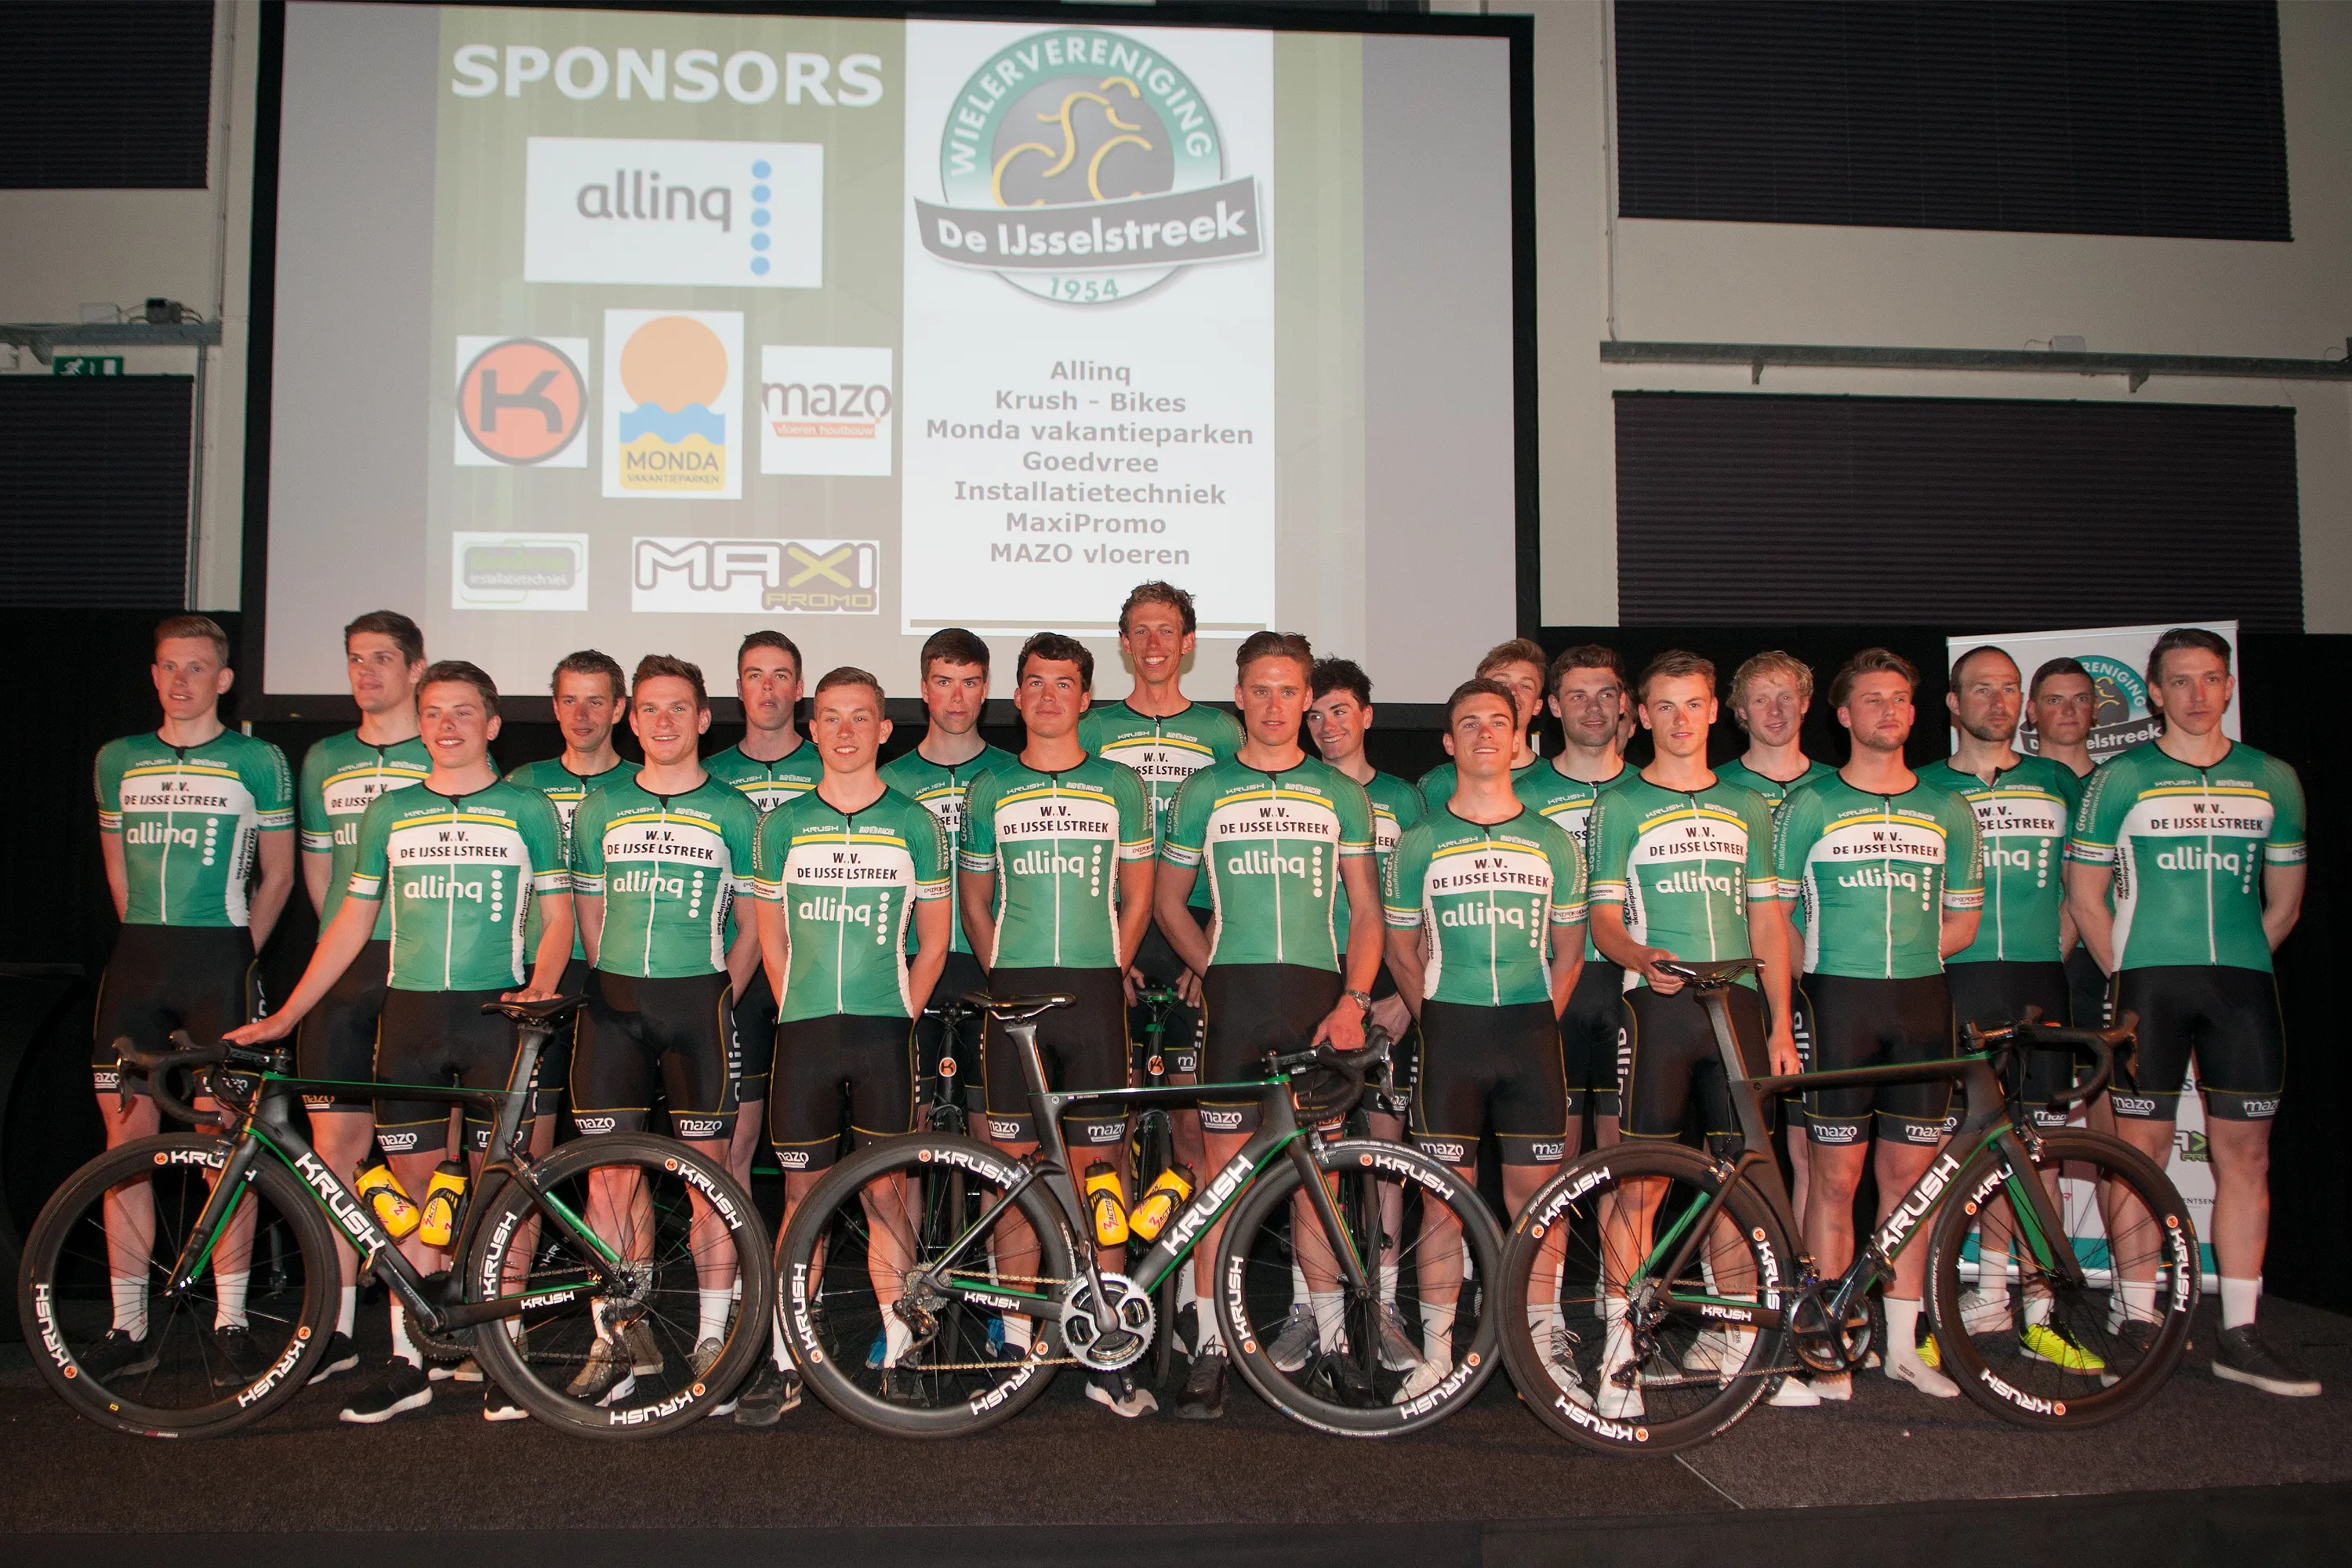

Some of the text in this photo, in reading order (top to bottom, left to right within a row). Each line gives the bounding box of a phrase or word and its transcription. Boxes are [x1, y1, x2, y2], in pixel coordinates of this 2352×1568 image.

[451, 43, 884, 107] SPONSORS
[949, 35, 1214, 177] WIELERVERENIGING
[575, 169, 732, 234] allinq
[938, 200, 1249, 256] De IJsselstreek
[1049, 276, 1120, 301] 1954
[1050, 360, 1131, 387] Allinq
[479, 368, 564, 434] K
[762, 383, 892, 418] mazo
[996, 389, 1079, 411] Krush
[1110, 392, 1186, 412] Bikes
[926, 419, 1253, 447] Monda vakantieparken
[626, 450, 719, 471] MONDA
[1022, 451, 1159, 473] Goedvree
[626, 474, 720, 485] VAKANTIEPARKEN
[954, 481, 1226, 504] Installatietechniek
[1006, 512, 1167, 534] MaxiPromo
[634, 539, 877, 591] MAXI
[990, 543, 1190, 565] MAZO vloeren
[764, 591, 873, 609] PROMO
[124, 794, 228, 808] DE IJSSELSTREEK
[331, 798, 343, 808] DE
[126, 822, 198, 848] allinq
[1004, 822, 1109, 835] DE IJSSELSTREEK
[1220, 822, 1329, 834] DE IJSSELSTREEK
[2151, 817, 2263, 831] DE IJSSELSTREEK
[401, 846, 508, 858] DE IJSSELSTREEK
[607, 844, 713, 860] DE IJSSELSTREEK
[1650, 841, 1744, 857] DE IJSSELSTREEK
[1833, 844, 1940, 858] DE IJSSELSTREEK
[2157, 846, 2240, 876] allinq
[797, 866, 897, 880] DE IJSSELSTREEK
[1013, 851, 1084, 878] allinq
[1228, 851, 1305, 878] allinq
[404, 875, 483, 903] allinq
[612, 871, 684, 898] allinq
[1432, 873, 1549, 889] DE IJSSELSTREEK
[1655, 870, 1732, 896] allinq
[799, 896, 872, 926] allinq
[1441, 902, 1524, 929] allinq
[934, 1149, 1014, 1190] KRUSH
[1374, 1154, 1456, 1200] KRUSH
[294, 1152, 387, 1255] KRUSH
[677, 1163, 743, 1229] KRUSH
[1161, 1154, 1254, 1256] KRUSH
[1539, 1166, 1611, 1227] KRUSH
[1880, 1153, 1960, 1257] KRUSH
[481, 1211, 518, 1295] KRUSH
[1755, 1240, 1780, 1311] KRUS
[2171, 1229, 2188, 1312] KRUSH
[520, 1290, 575, 1311] KRUSH
[792, 1263, 817, 1352] KRUSH
[964, 1290, 1021, 1311] KRUSH
[1228, 1256, 1252, 1340] KRUSH
[34, 1283, 71, 1368] KRUSH
[1700, 1304, 1752, 1323] KRUSH
[236, 1341, 307, 1409] KRUSH
[1399, 1365, 1475, 1421] KRUSH
[1980, 1367, 2053, 1415] KRUSH
[609, 1390, 696, 1425] KRUSH
[1554, 1386, 1633, 1442] KRUSH
